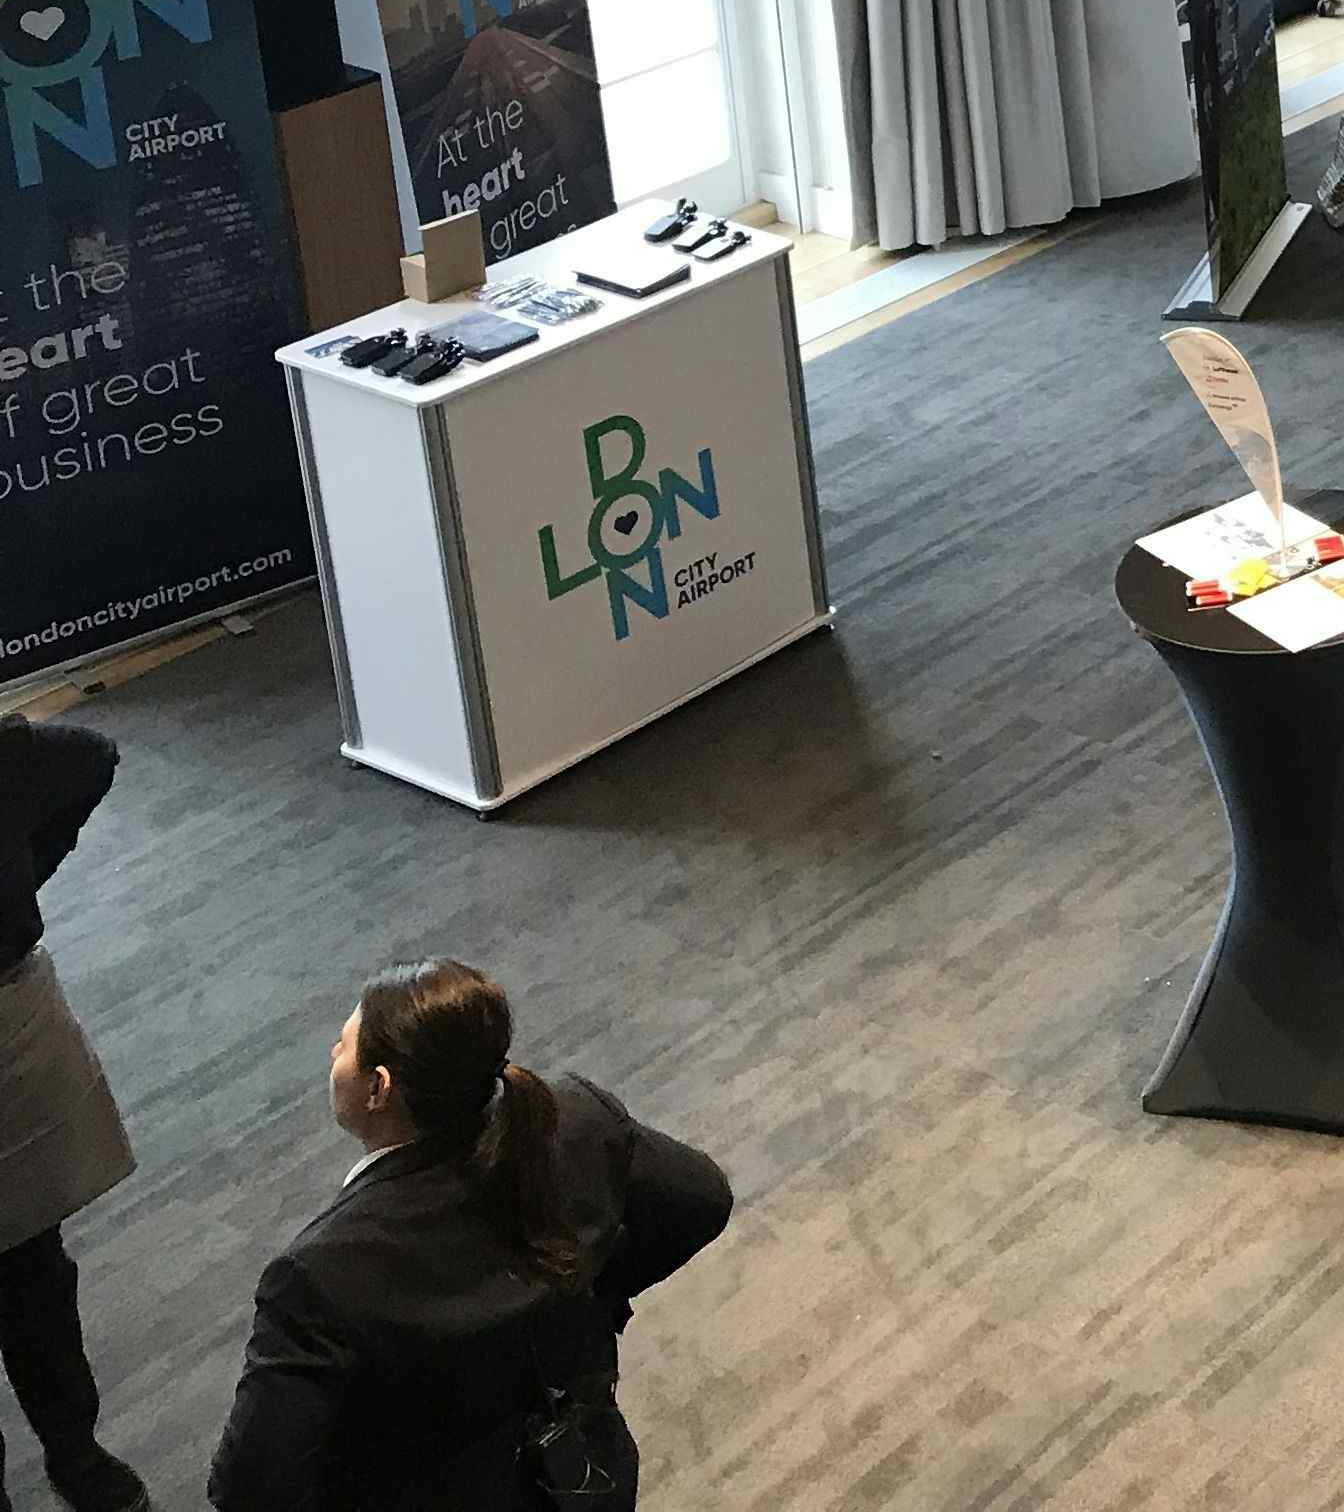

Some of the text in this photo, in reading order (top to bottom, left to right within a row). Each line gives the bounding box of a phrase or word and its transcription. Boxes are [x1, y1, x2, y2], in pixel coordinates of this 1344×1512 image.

[126, 113, 178, 143] CITY
[128, 121, 227, 163] AIRPORT
[436, 99, 524, 179] At the
[442, 146, 526, 218] heart
[490, 173, 570, 260] great
[23, 260, 127, 312] the
[0, 312, 124, 381] eart
[42, 347, 207, 436] great
[674, 551, 719, 588] CITY
[677, 551, 757, 610] AIRPORT
